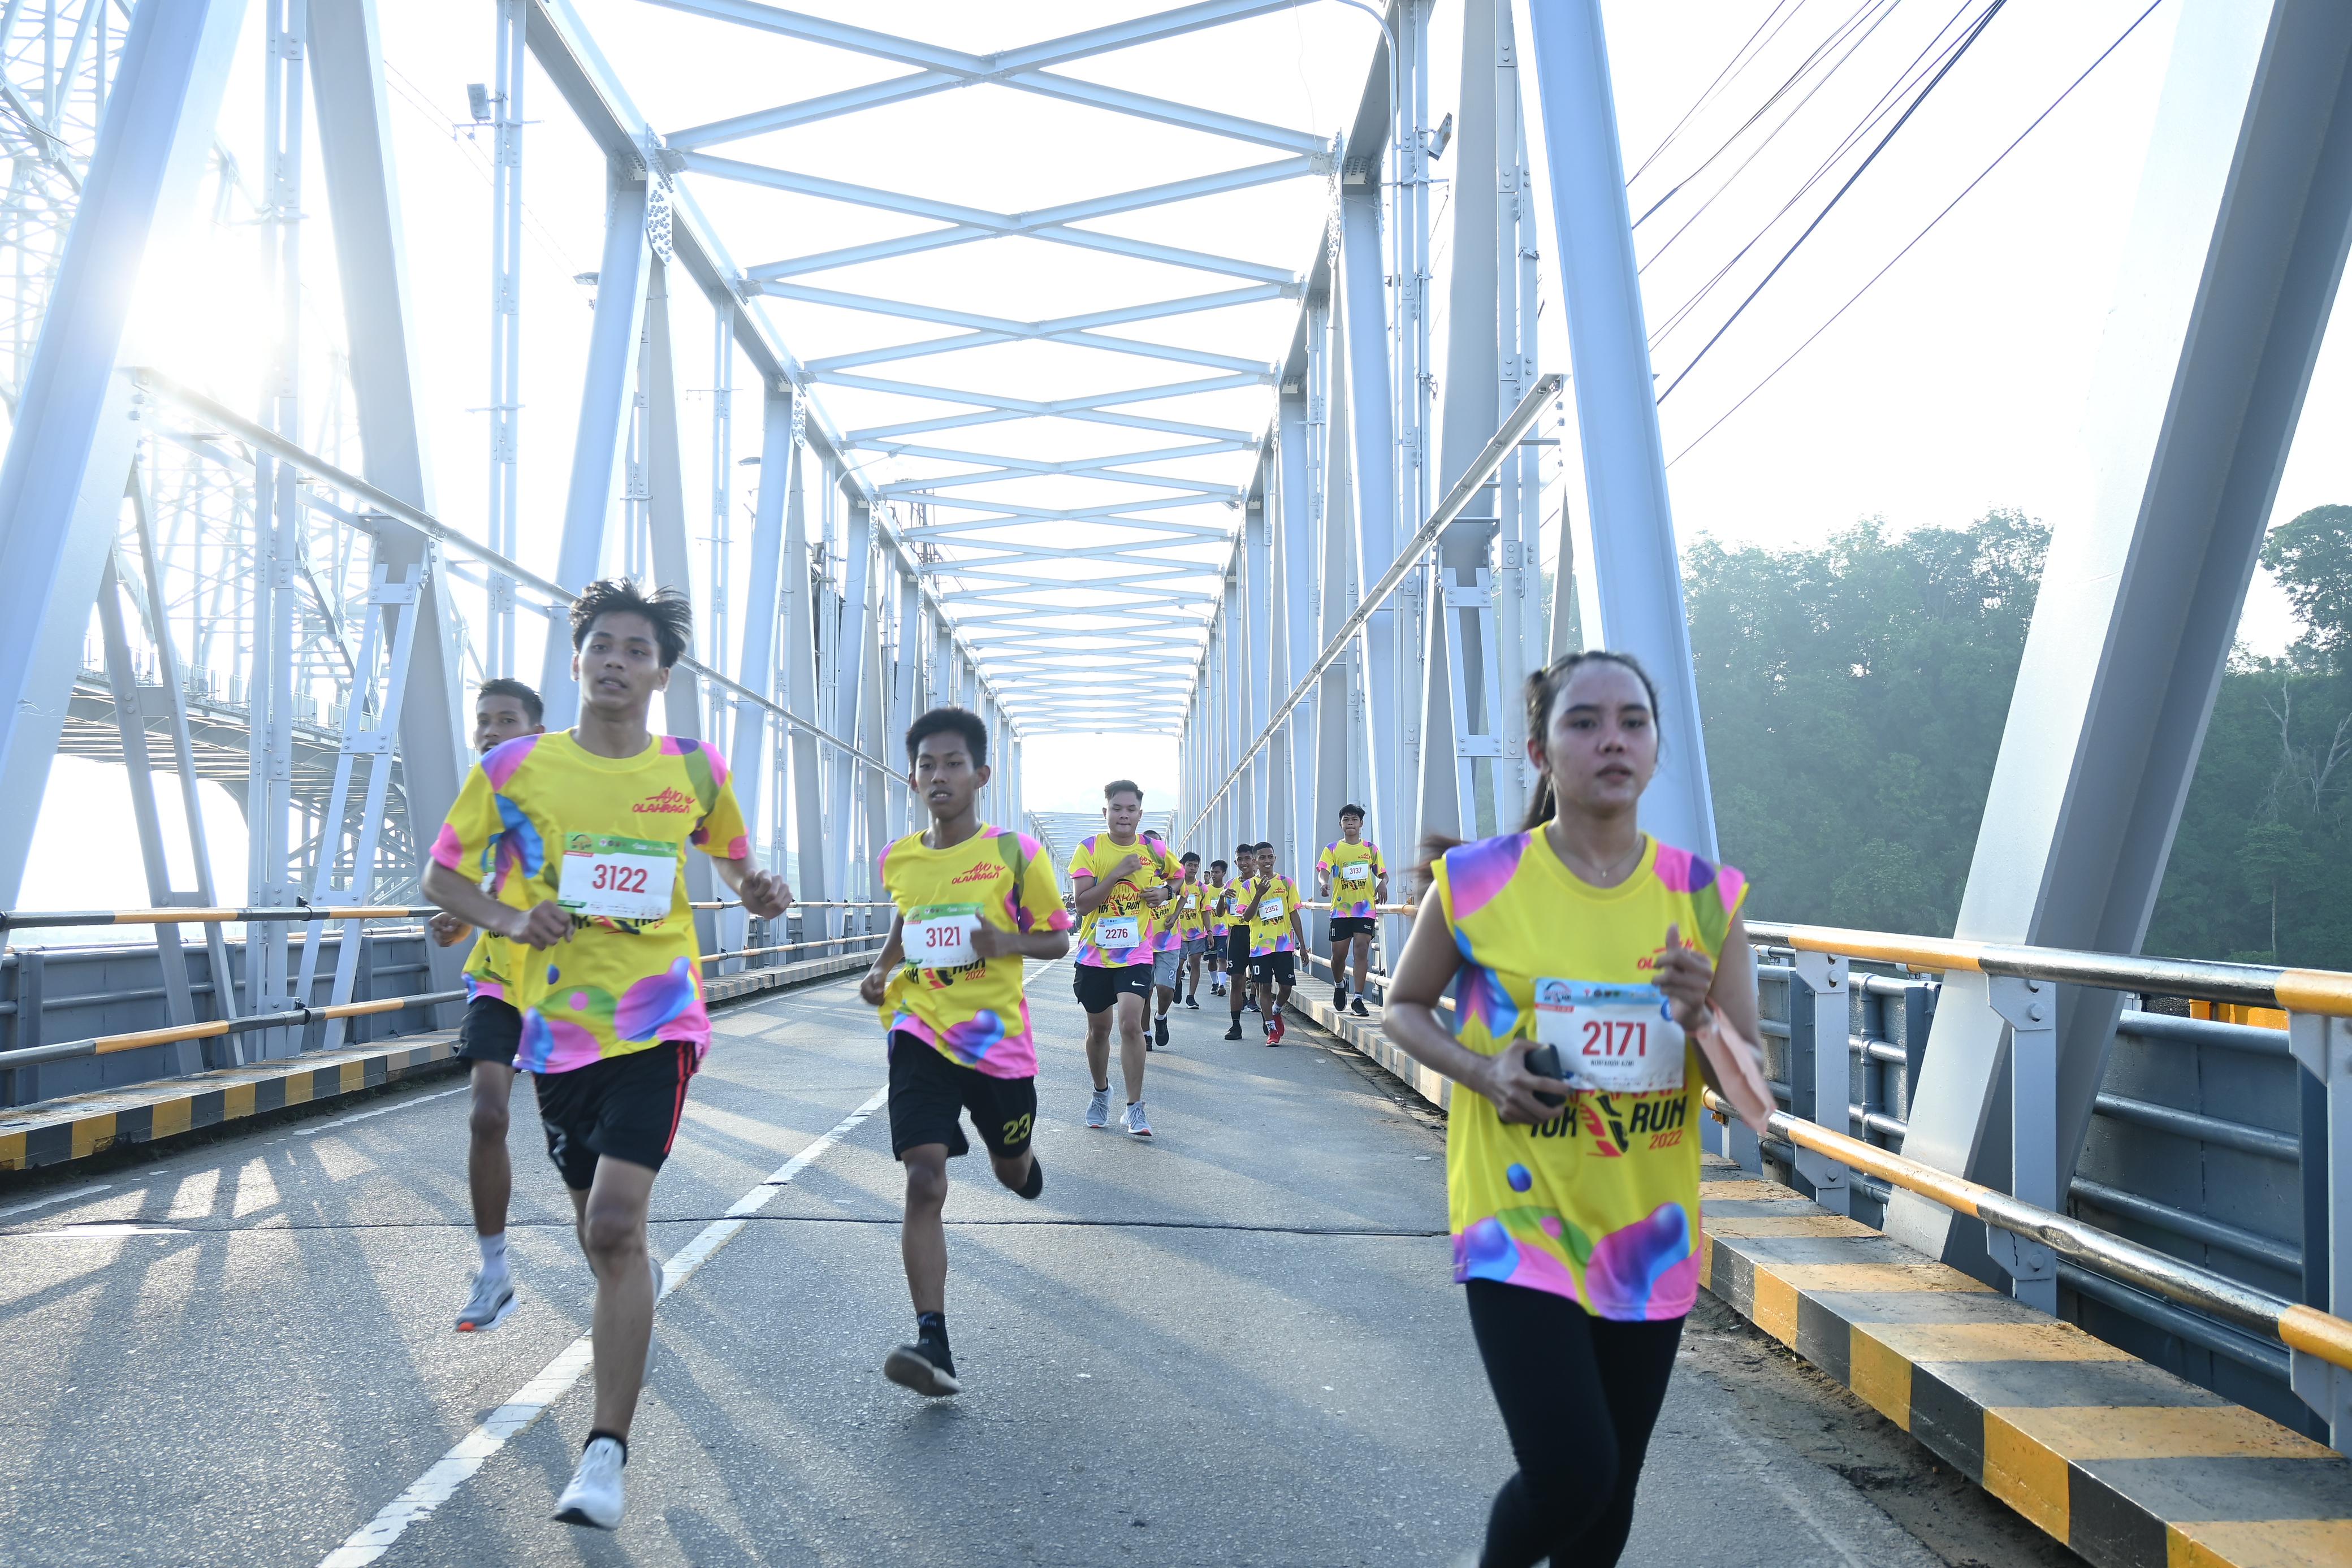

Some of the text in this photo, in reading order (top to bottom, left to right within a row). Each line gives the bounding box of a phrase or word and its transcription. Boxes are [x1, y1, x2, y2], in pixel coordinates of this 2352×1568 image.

[632, 804, 690, 813] OLAHRAGA
[592, 864, 648, 893] 3122
[1125, 900, 1141, 911] RUN
[1264, 904, 1279, 913] 2352
[926, 926, 961, 948] 3121
[1105, 928, 1129, 939] 2276
[1331, 928, 1335, 937] 11
[965, 968, 986, 981] 2022
[1582, 1021, 1647, 1057] 2171
[1629, 1095, 1688, 1133] RUN
[1003, 1112, 1031, 1145] 23
[1649, 1129, 1683, 1150] 2022
